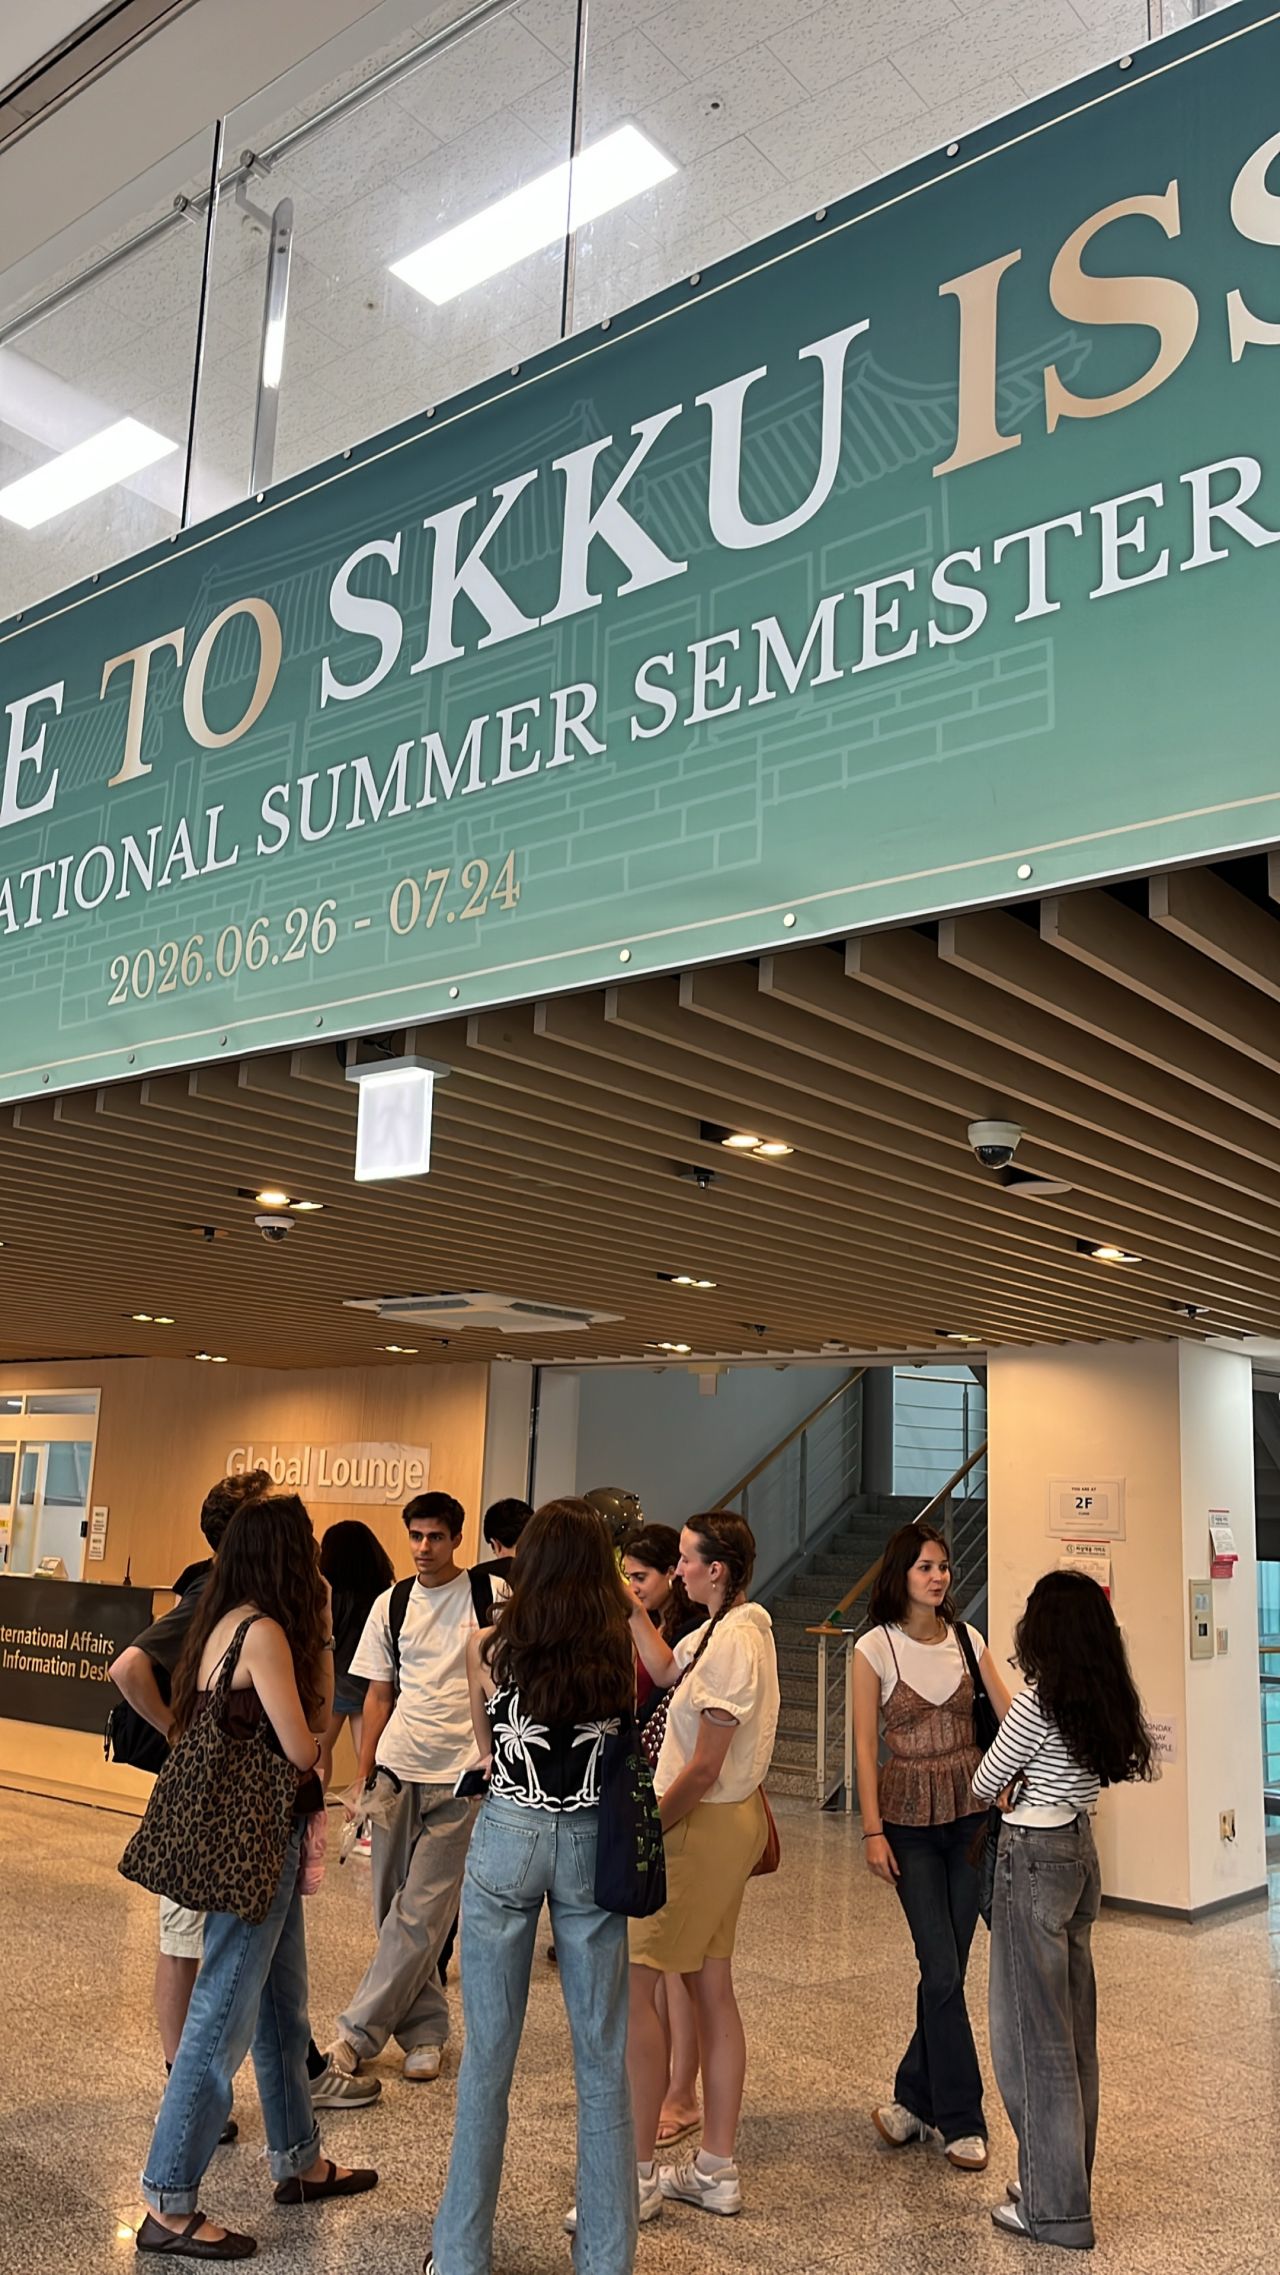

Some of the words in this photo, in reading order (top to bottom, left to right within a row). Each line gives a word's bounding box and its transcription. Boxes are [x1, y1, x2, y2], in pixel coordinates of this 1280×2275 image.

[100, 598, 282, 788] TO
[320, 318, 870, 709] SKKU
[256, 683, 606, 856] SUMMER
[630, 456, 1280, 742] SEMESTER
[108, 898, 337, 1006] 2026.06.26
[354, 917, 371, 929] -
[390, 850, 520, 937] 07.24
[317, 1449, 424, 1500] Lounge
[1075, 1497, 1093, 1509] 2F
[0, 1625, 68, 1649] ternational
[70, 1631, 115, 1655] Affairs
[2, 1648, 76, 1677] Information
[80, 1659, 111, 1682] Desk
